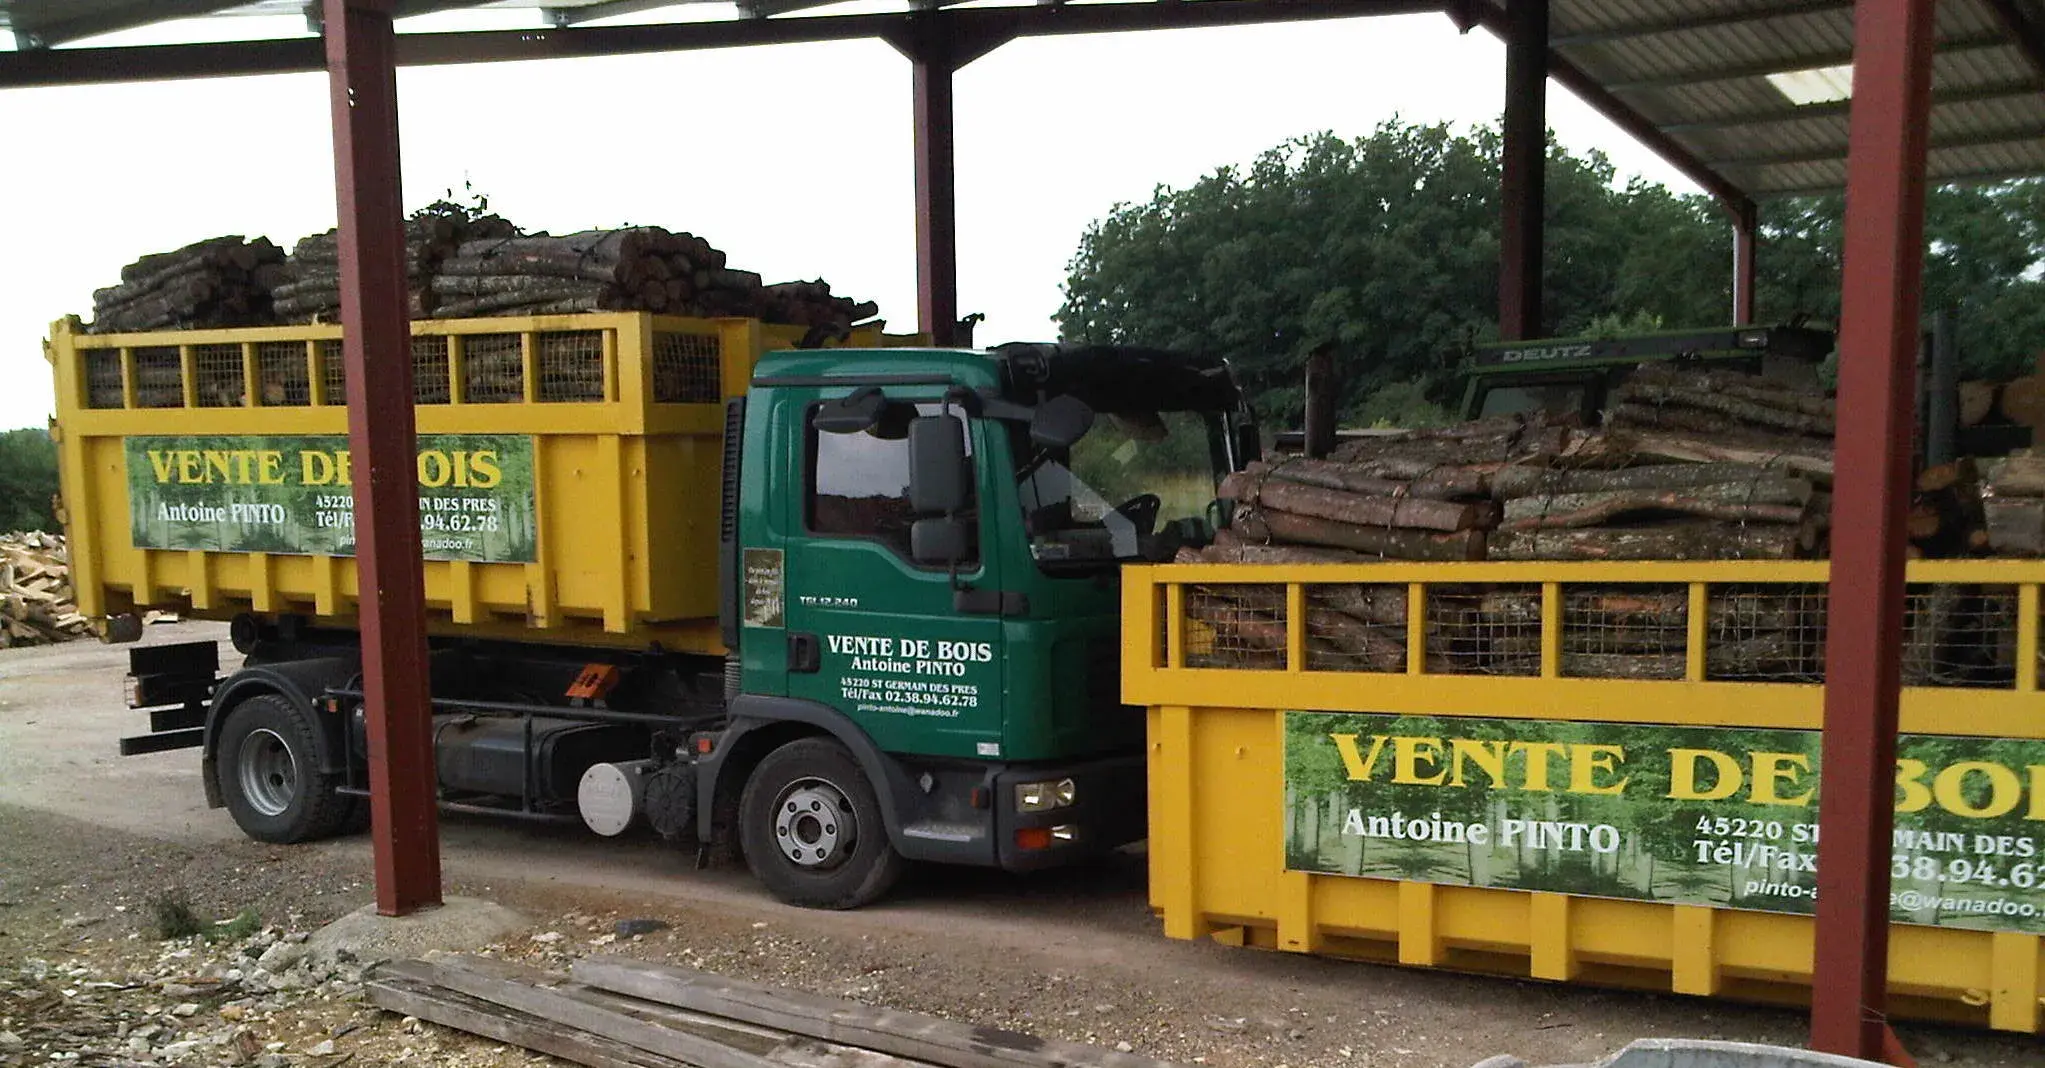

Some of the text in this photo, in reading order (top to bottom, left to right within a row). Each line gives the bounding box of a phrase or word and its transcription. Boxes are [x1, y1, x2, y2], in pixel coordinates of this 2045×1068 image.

[1503, 345, 1592, 362] DEUTZ
[147, 450, 286, 485] VENTE
[417, 450, 502, 488] OIS
[157, 501, 286, 525] Antoine PINTO
[316, 495, 353, 508] 45220
[434, 498, 459, 511] DES
[463, 498, 496, 511] PRES
[316, 510, 355, 529] Tél/F
[827, 635, 992, 662] VENTE DE BOIS
[851, 657, 966, 677] Antoine PINTO
[840, 677, 978, 695] 45220 ST GERMAIN DES PRES
[841, 687, 978, 707] Tél/Fax 02.38.94.62.78
[1330, 733, 1629, 794] VENTE
[1666, 748, 1816, 807] DE
[1342, 808, 1620, 853] Antoine PINTO
[1695, 815, 2035, 857] 45220 ST MAIN DES
[1693, 839, 1818, 873] Tél/Fax
